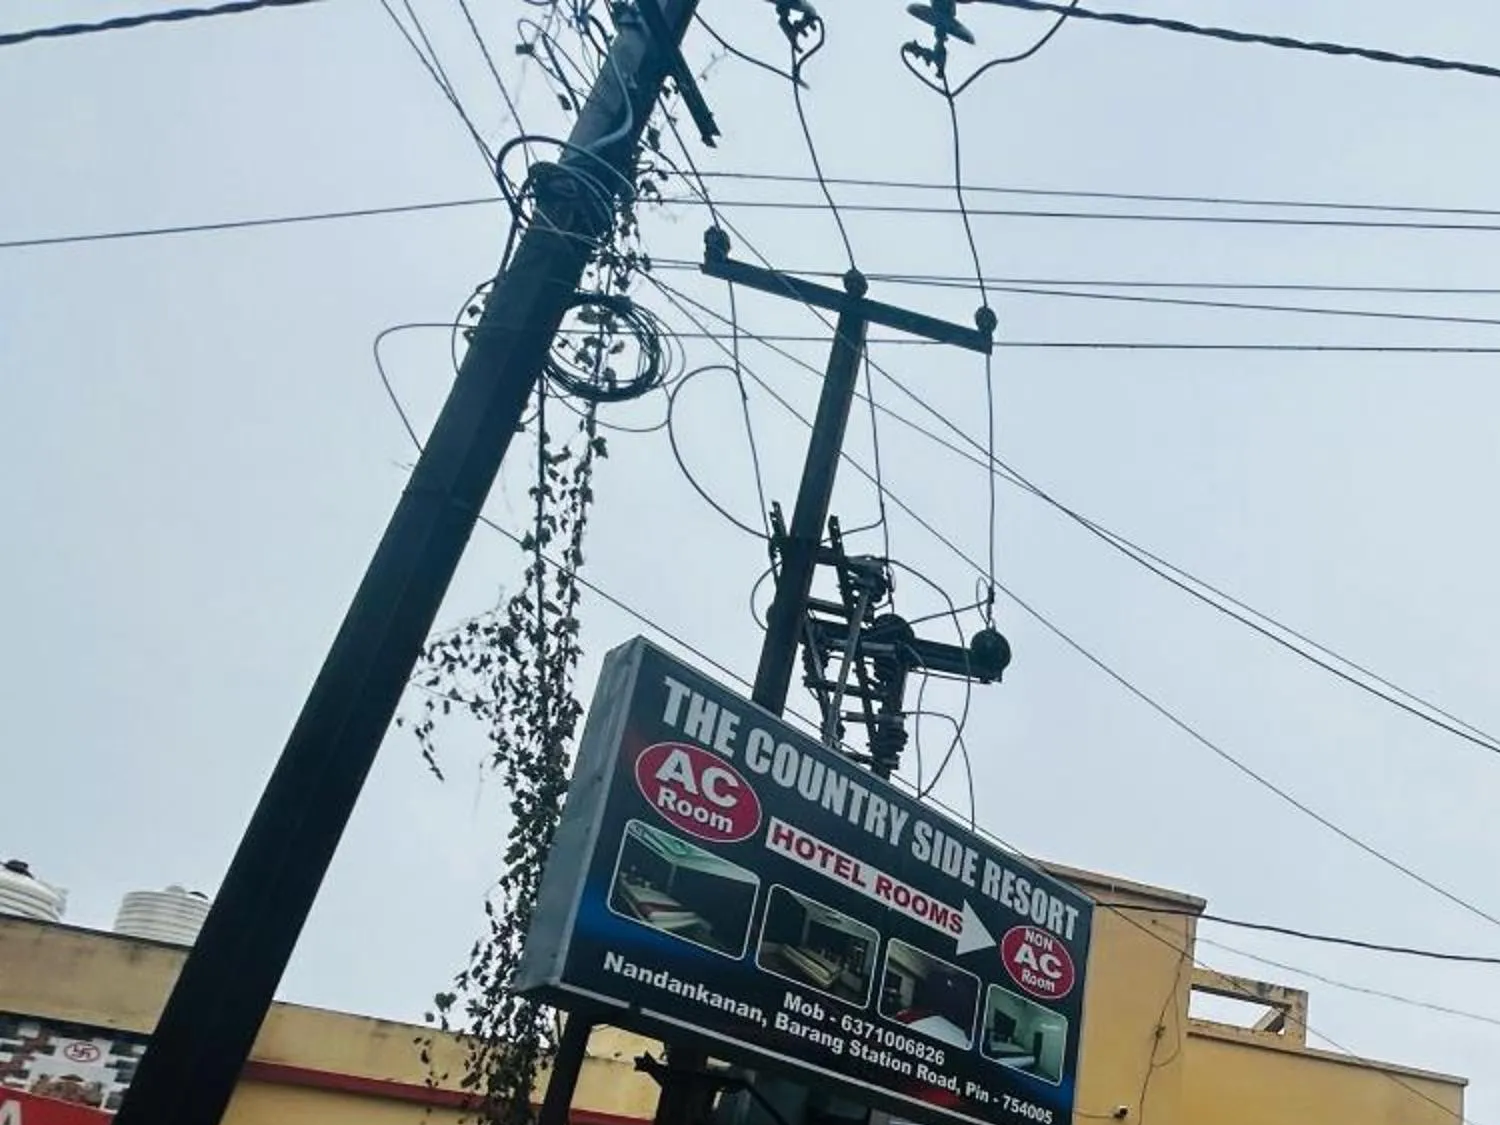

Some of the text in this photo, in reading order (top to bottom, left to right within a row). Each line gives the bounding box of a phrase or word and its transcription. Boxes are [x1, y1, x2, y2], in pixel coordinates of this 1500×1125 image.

[655, 749, 739, 808] AC
[663, 676, 1080, 940] THE COUNTRY SIDE RESORT
[657, 787, 734, 834] Room
[771, 823, 963, 935] HOTEL ROOMS
[1014, 944, 1062, 979] AC
[1024, 928, 1053, 951] NON
[1021, 969, 1055, 992] Room
[603, 951, 769, 1027] Nandankanan,
[774, 1011, 844, 1055] Barang
[849, 1041, 911, 1075] Station
[916, 1064, 961, 1095] Road,
[966, 1081, 989, 1103] Pin
[1003, 1095, 1053, 1125] 754005
[783, 991, 825, 1021] Mob
[841, 1014, 945, 1066] 6371006826
